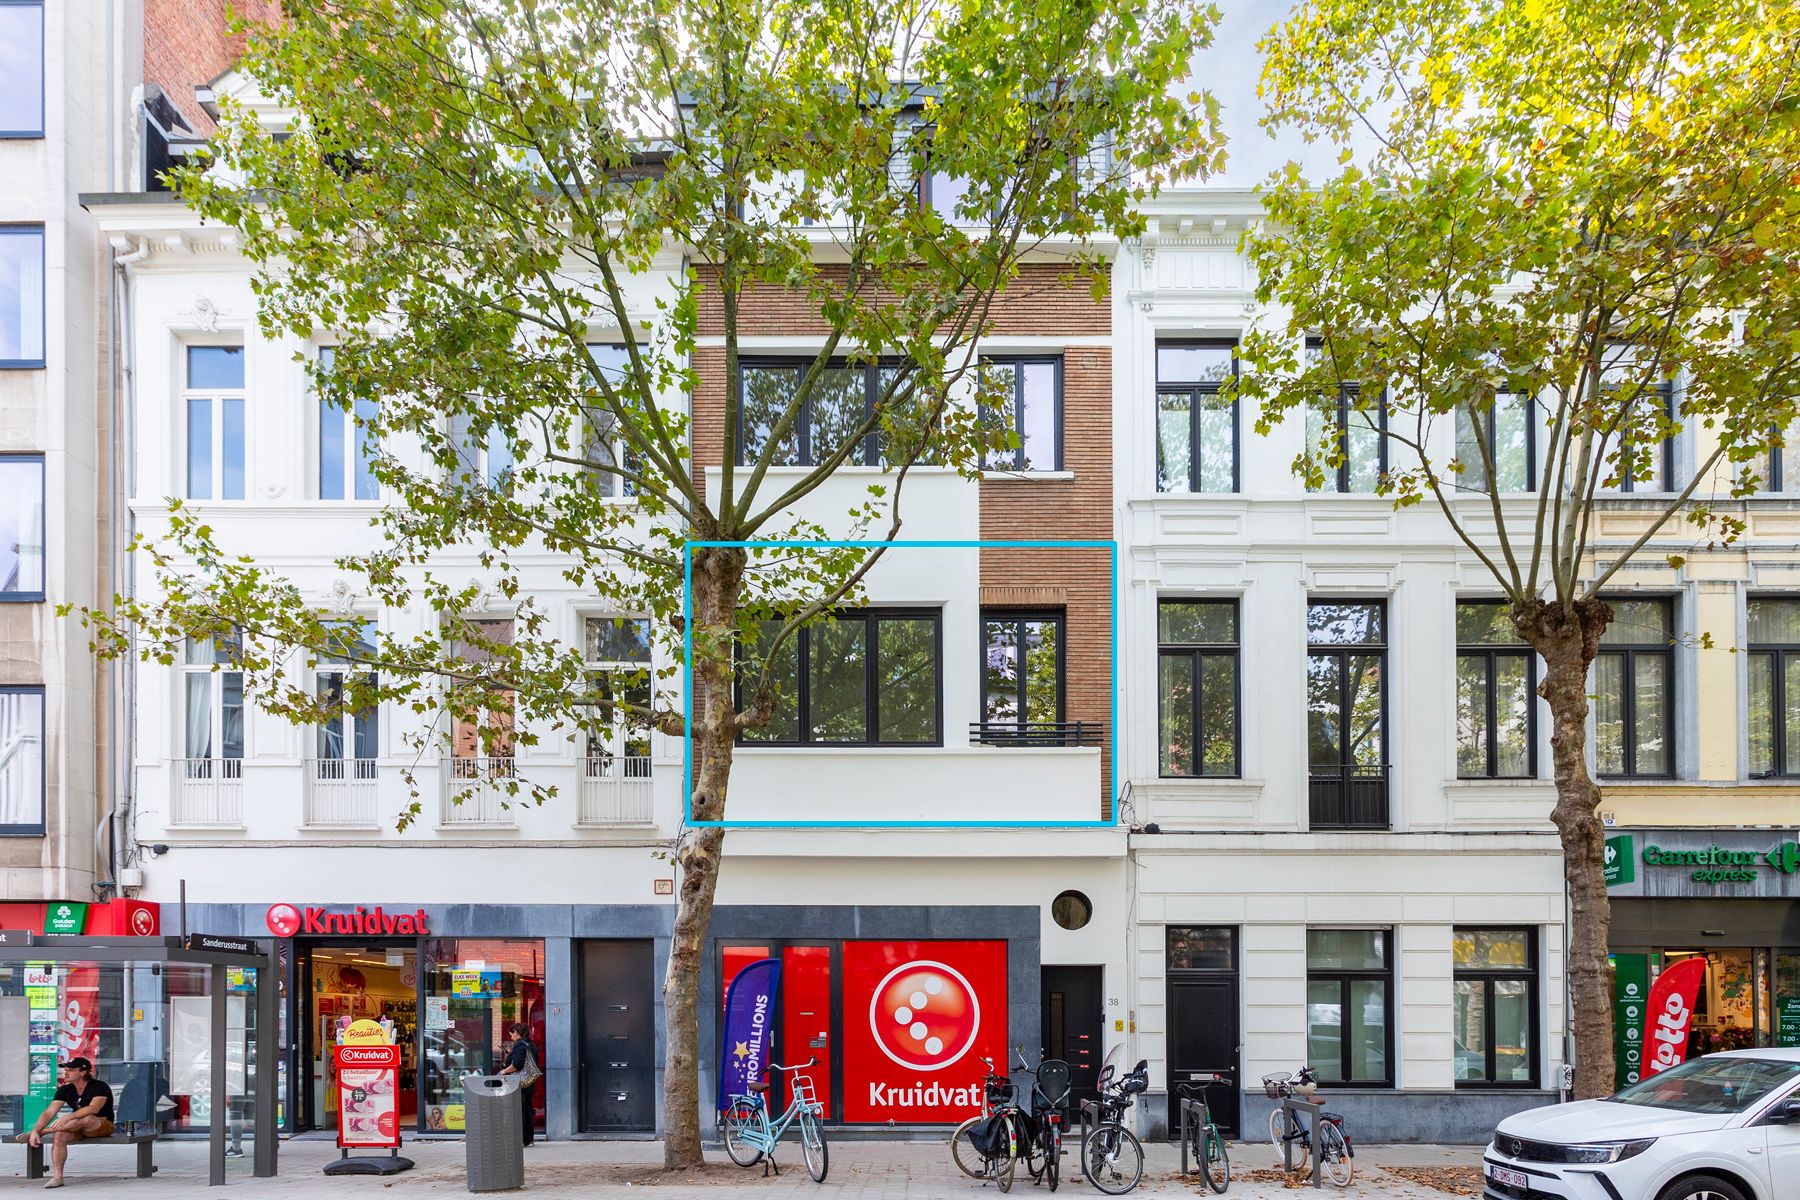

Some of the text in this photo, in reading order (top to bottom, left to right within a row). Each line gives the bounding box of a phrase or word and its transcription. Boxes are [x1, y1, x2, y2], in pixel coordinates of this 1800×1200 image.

[1643, 845, 1758, 867] Carrefour
[1692, 869, 1758, 885] express
[305, 906, 429, 934] Kruidvat
[202, 937, 247, 951] Sanderusstraat
[1109, 998, 1120, 1006] 38
[354, 1050, 390, 1060] Kruidvat
[869, 1081, 982, 1107] Kruidvat
[1494, 1169, 1526, 1187] 2-DMS-092
